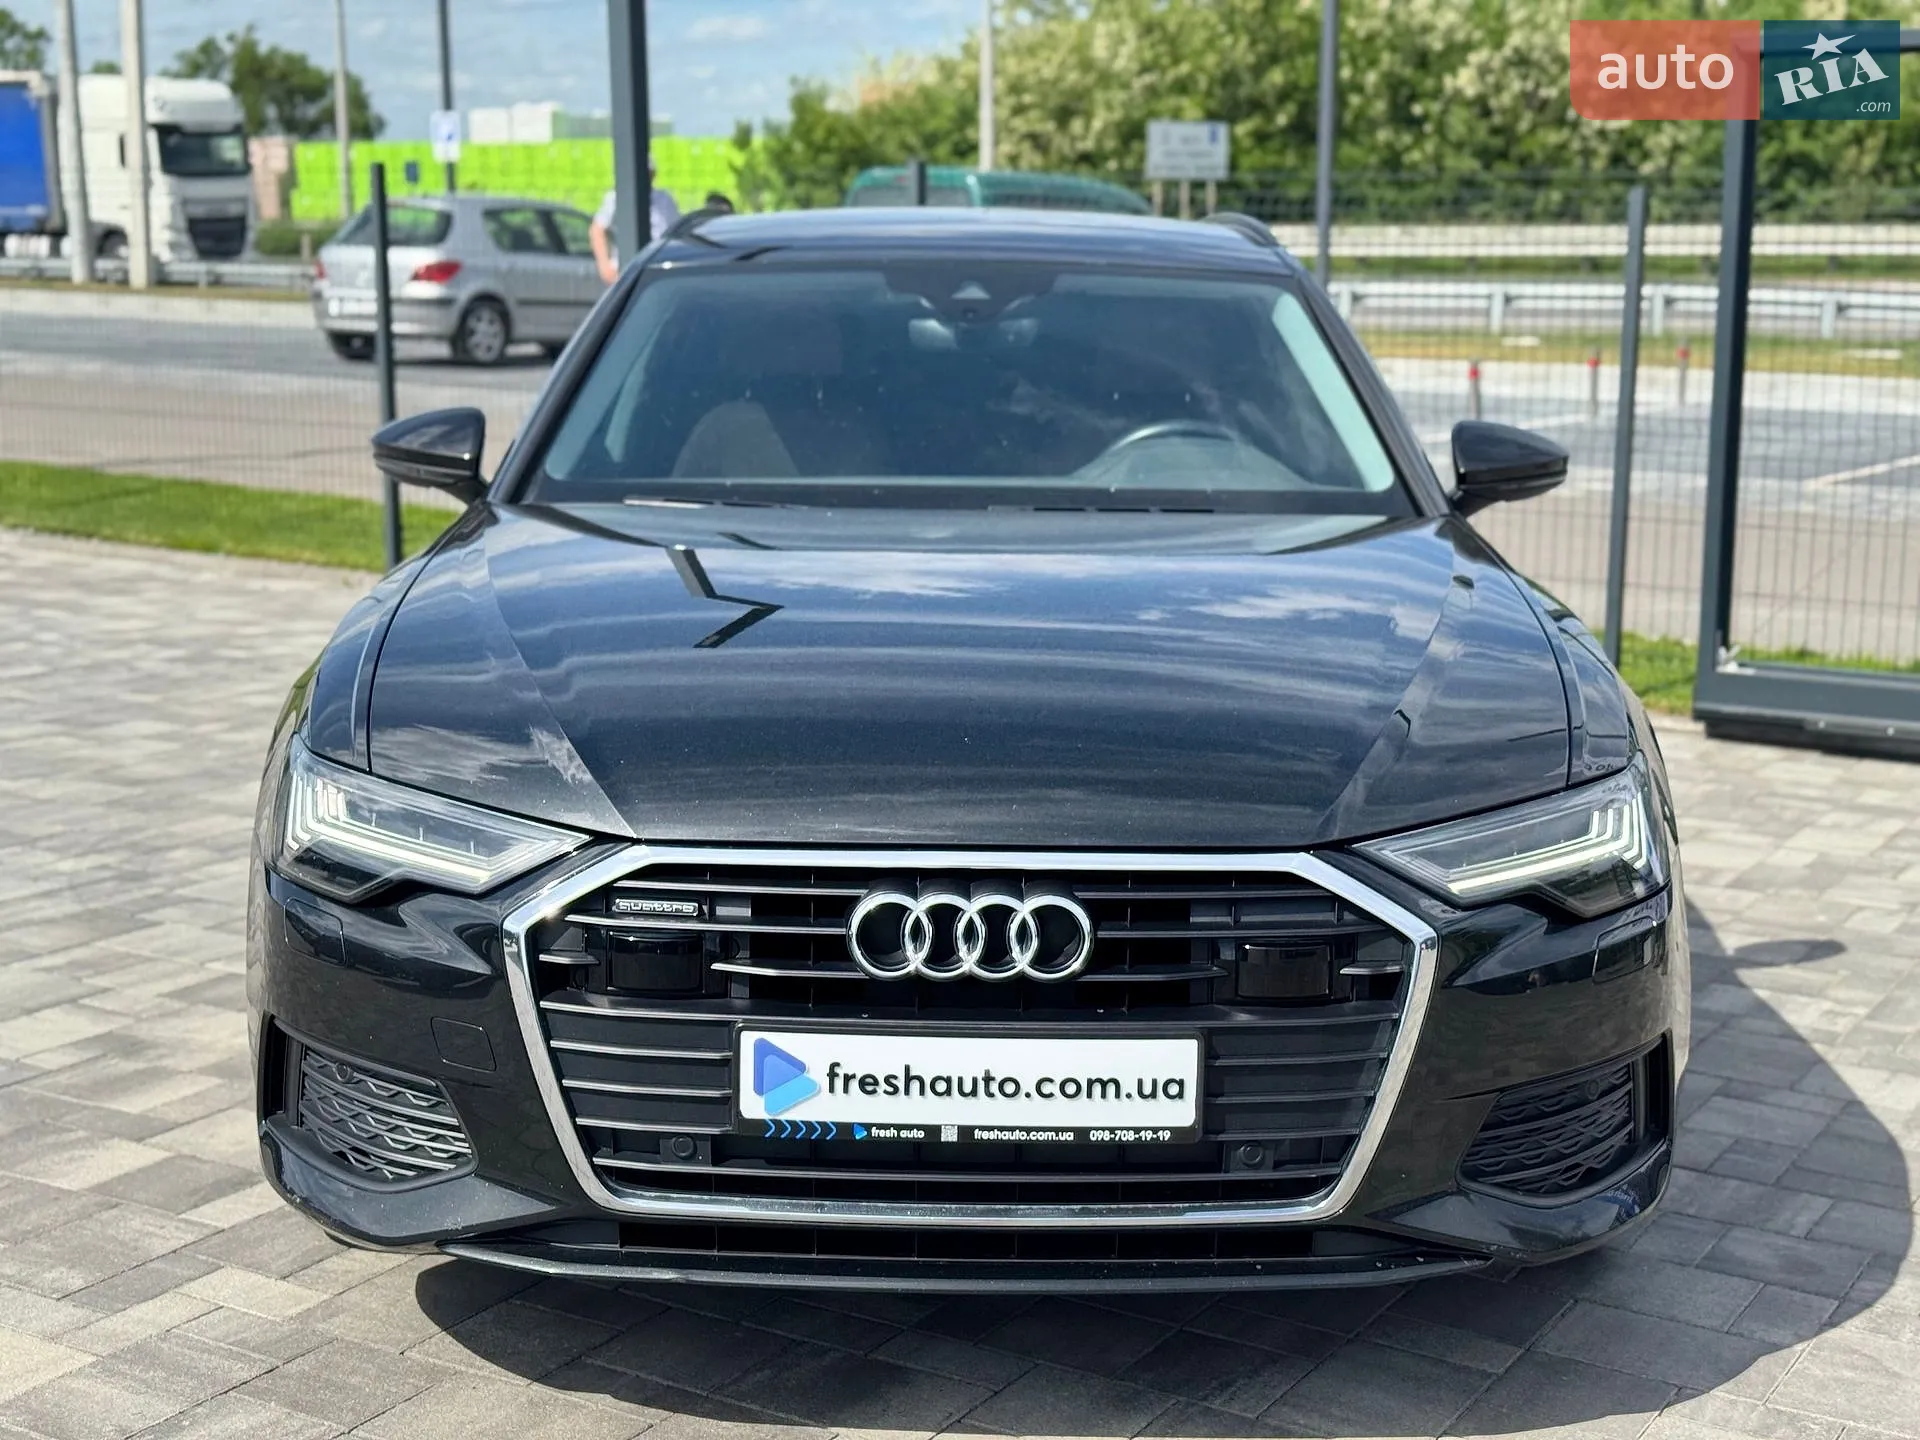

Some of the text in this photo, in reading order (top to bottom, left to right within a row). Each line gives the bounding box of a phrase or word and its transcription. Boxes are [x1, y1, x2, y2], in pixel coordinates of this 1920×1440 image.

[619, 901, 695, 913] quattro
[827, 1062, 1185, 1099] freshauto.com.ua
[871, 1126, 925, 1139] fresh auto
[974, 1128, 1074, 1141] freshauto.com.ua
[1090, 1129, 1171, 1141] 098-708-19-19
